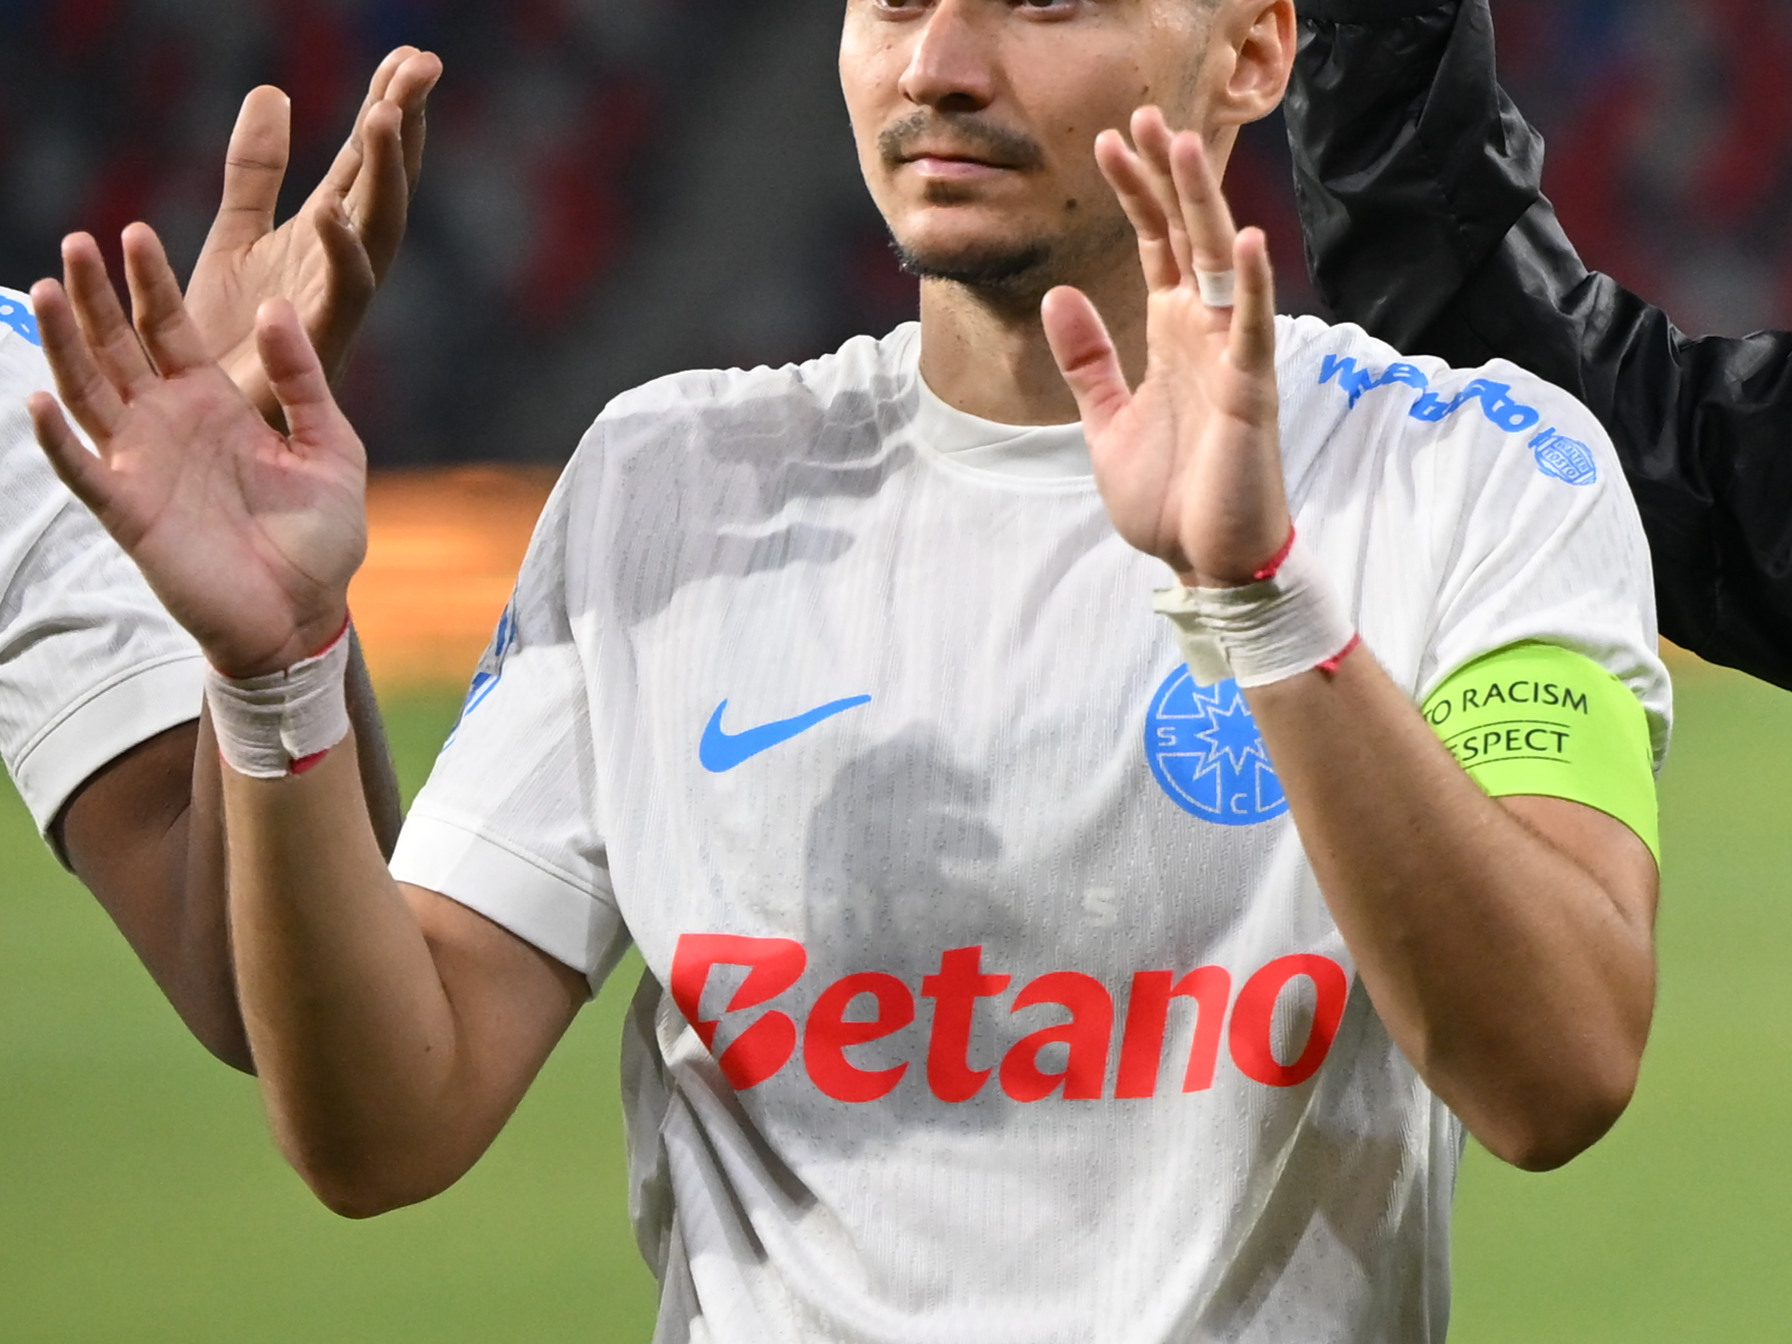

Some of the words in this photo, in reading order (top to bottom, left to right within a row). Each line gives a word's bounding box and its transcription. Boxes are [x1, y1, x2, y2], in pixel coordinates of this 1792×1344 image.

[1543, 449, 1577, 477] TOSTO
[1462, 680, 1588, 715] RACISM
[1156, 726, 1178, 747] S
[1448, 729, 1570, 762] SPECT
[1229, 792, 1249, 815] C
[670, 932, 1348, 1104] Betano
